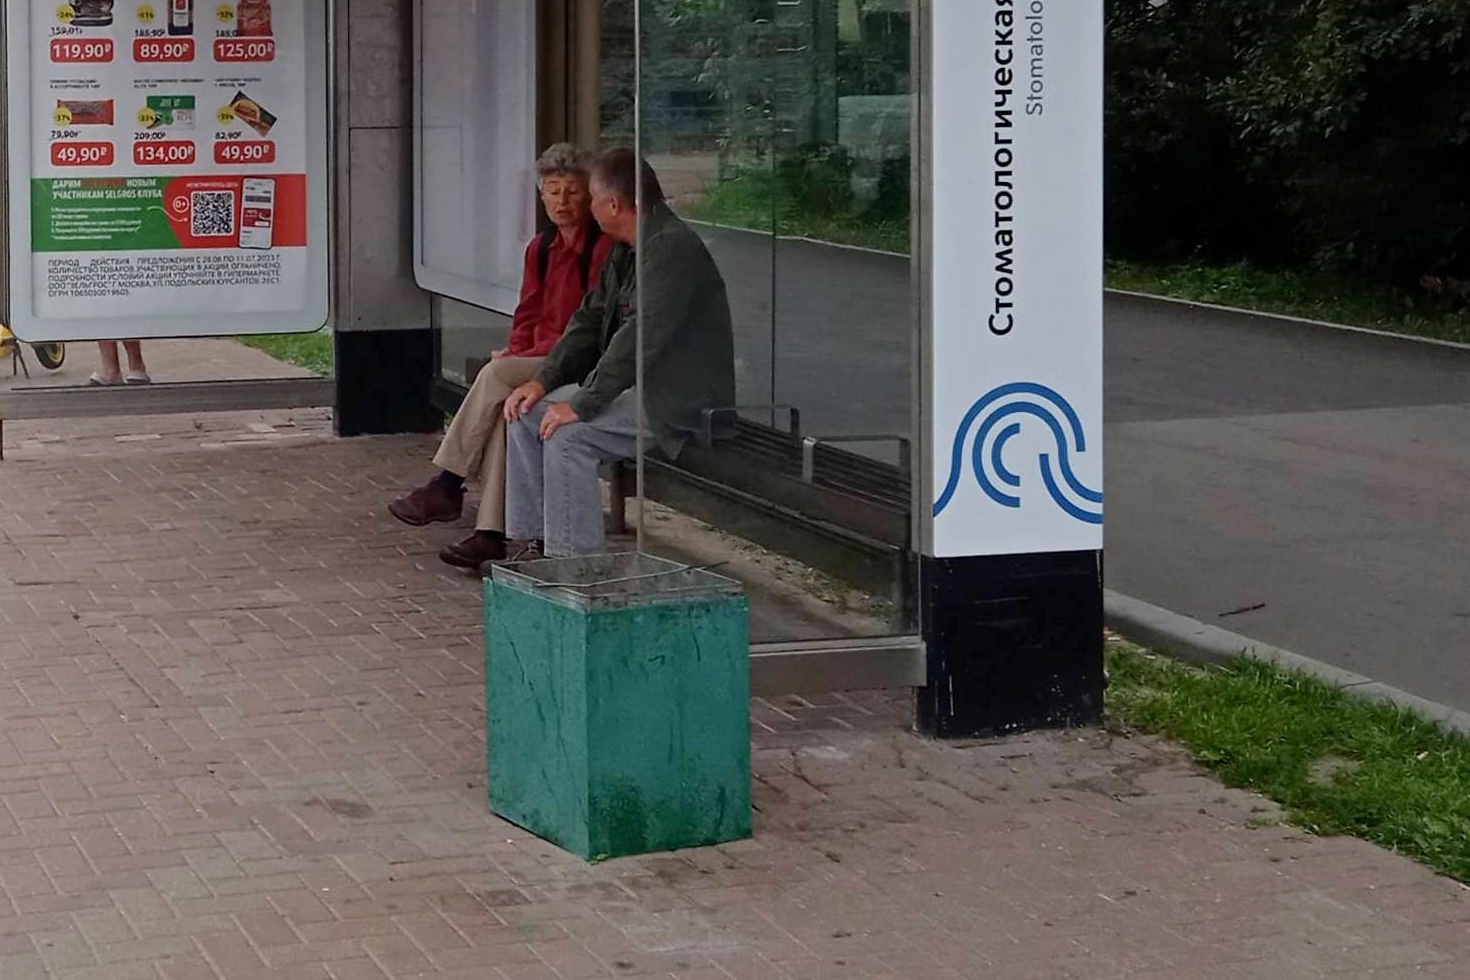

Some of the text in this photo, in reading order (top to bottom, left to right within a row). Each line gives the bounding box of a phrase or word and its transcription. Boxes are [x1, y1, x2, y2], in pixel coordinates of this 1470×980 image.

[52, 179, 82, 189] ДАРИМ
[127, 179, 156, 187] НОВЫМ
[52, 189, 163, 199] УЧАСТНИКАМ SELGROS КЛУБА
[90, 258, 130, 266] ДЕЙСТВИЯ
[48, 266, 98, 274] КОЛИЧЕСТВО
[48, 274, 106, 282] ПОДРОБНОСТИ
